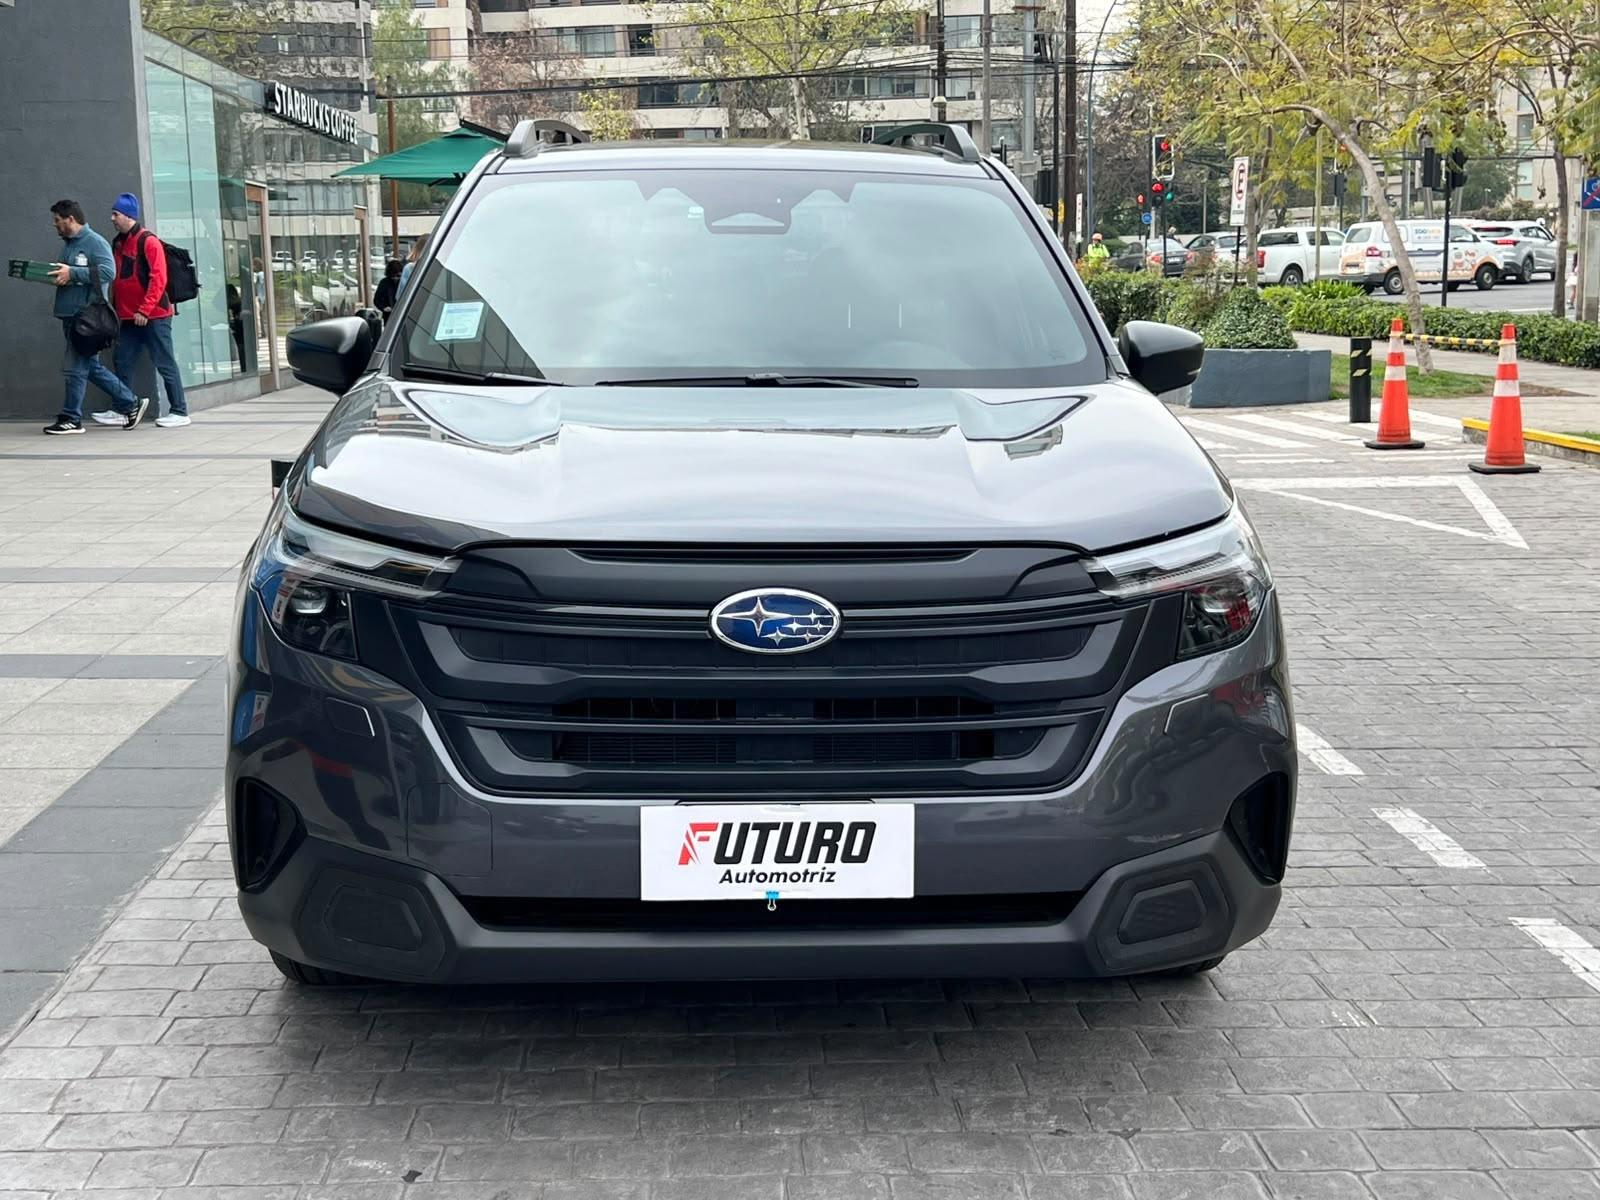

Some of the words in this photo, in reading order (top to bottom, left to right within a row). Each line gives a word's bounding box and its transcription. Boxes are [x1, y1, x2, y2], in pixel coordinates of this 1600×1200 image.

[275, 82, 330, 133] STARBUCKS
[331, 108, 358, 145] COFFEE
[678, 821, 876, 866] FUTURO
[720, 867, 836, 884] Automotriz
